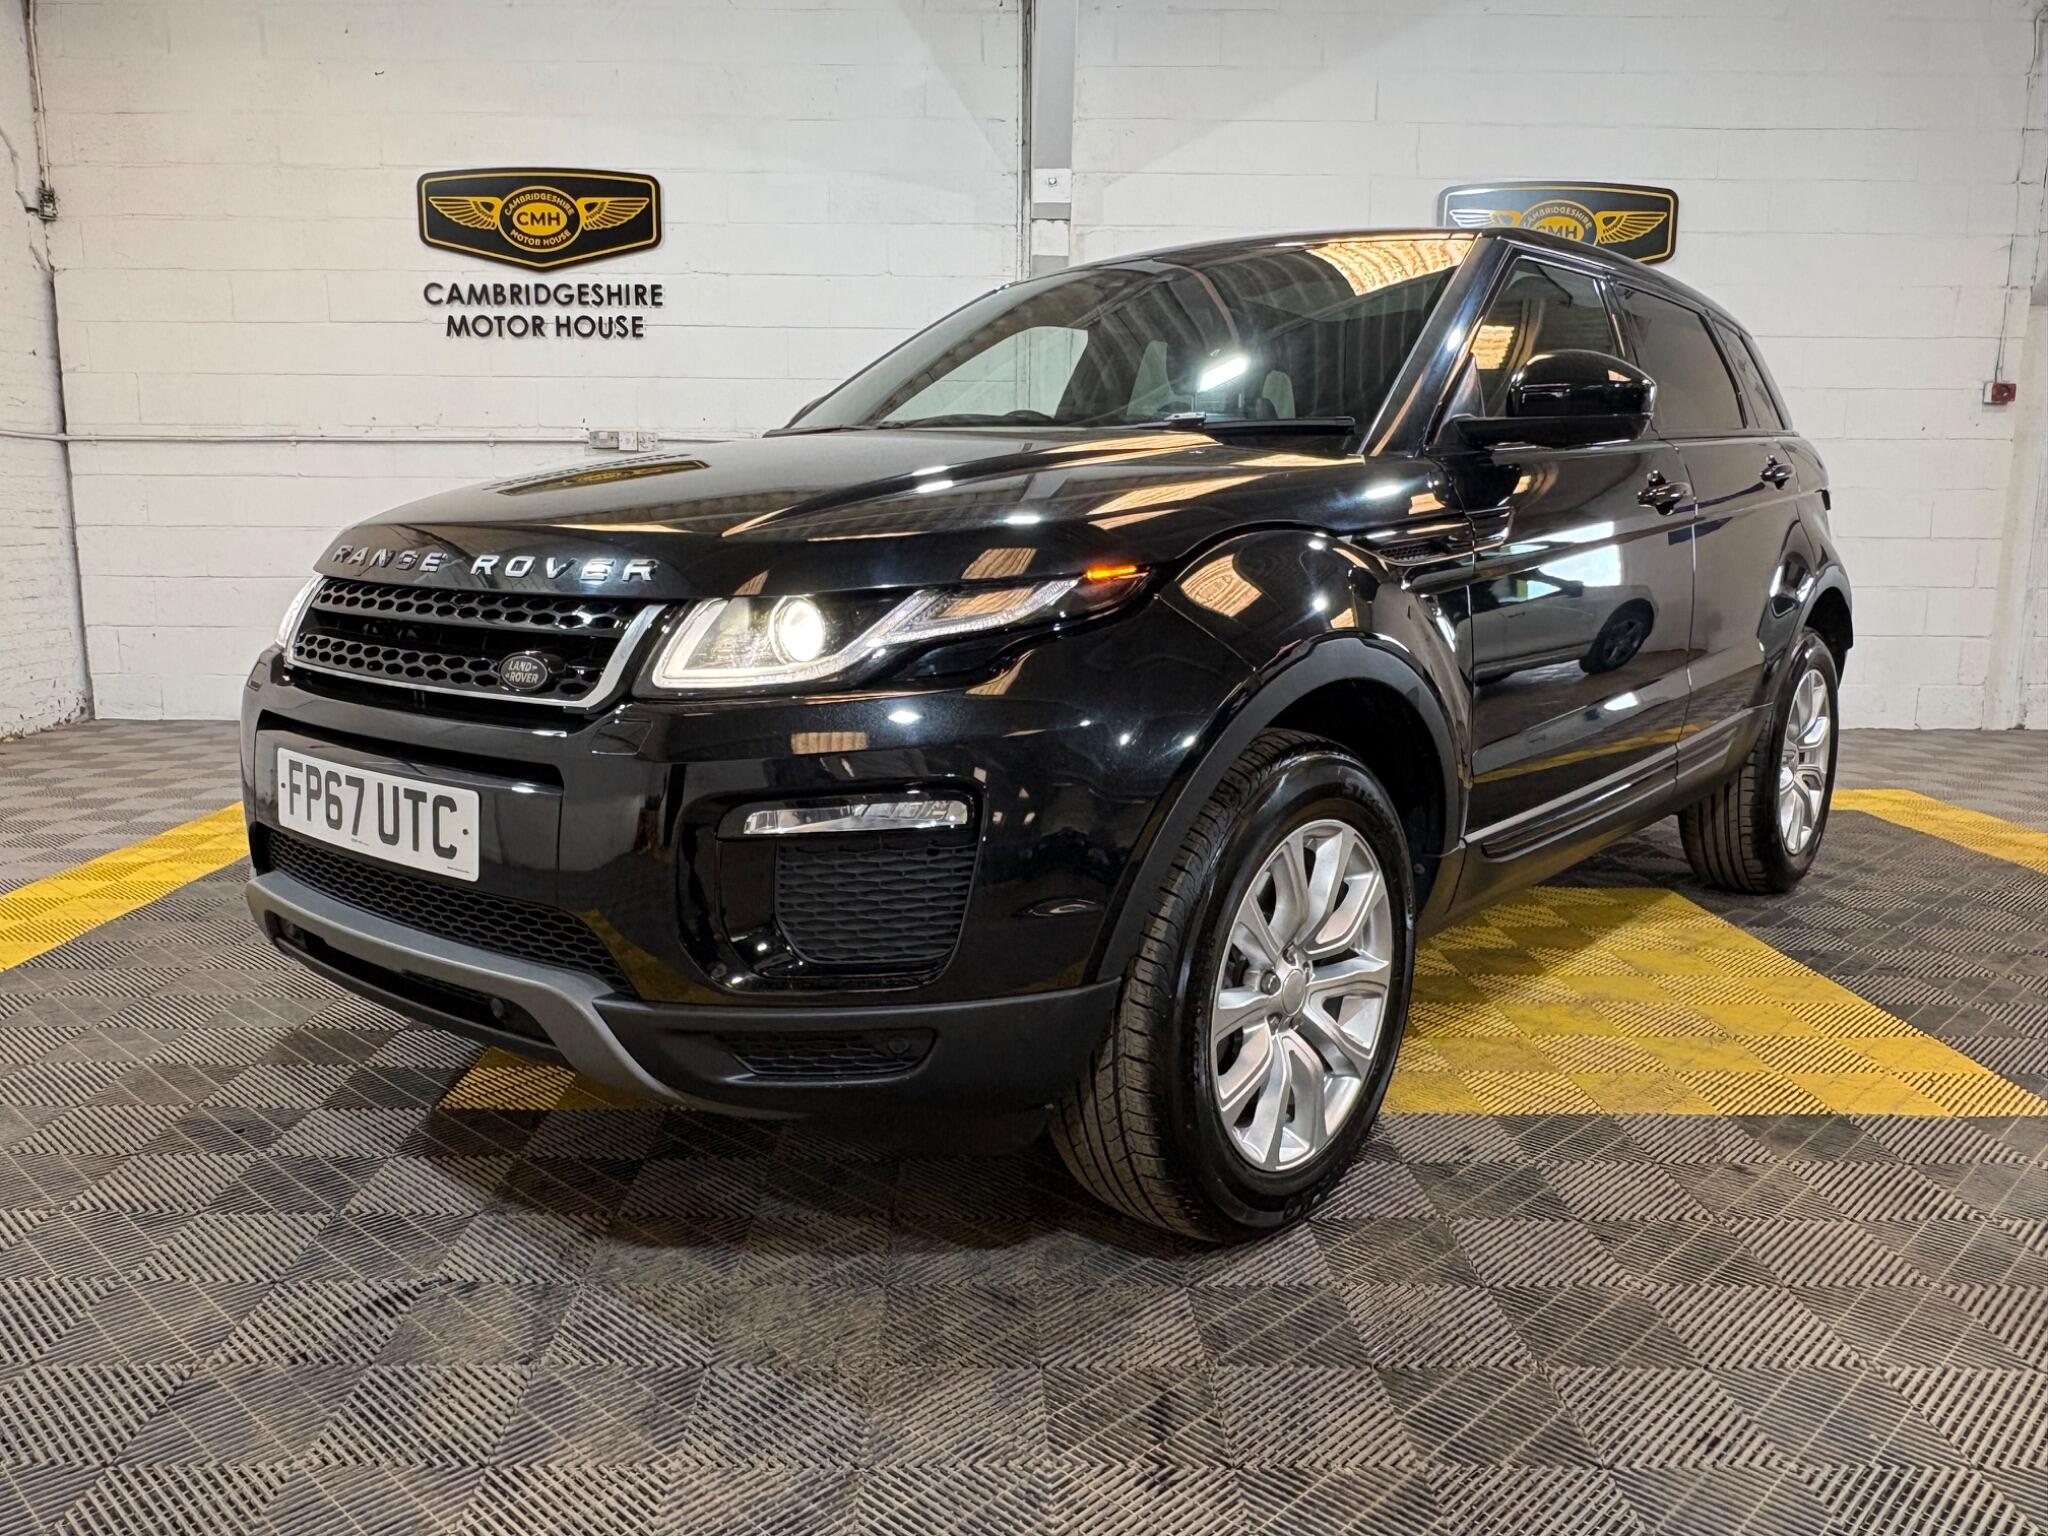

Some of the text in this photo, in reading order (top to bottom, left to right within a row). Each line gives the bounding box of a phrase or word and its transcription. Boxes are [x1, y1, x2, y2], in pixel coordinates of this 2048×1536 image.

[504, 192, 575, 216] CAMBRIDGESHIRE
[516, 211, 561, 226] CMH
[510, 229, 572, 246] MOTOR HOUSE
[423, 282, 664, 306] CAMBRIDGESHIRE
[446, 315, 644, 339] MOTOR HOUSE
[331, 544, 660, 583] RANGE ROVER
[288, 759, 458, 860] FP67 UTC
